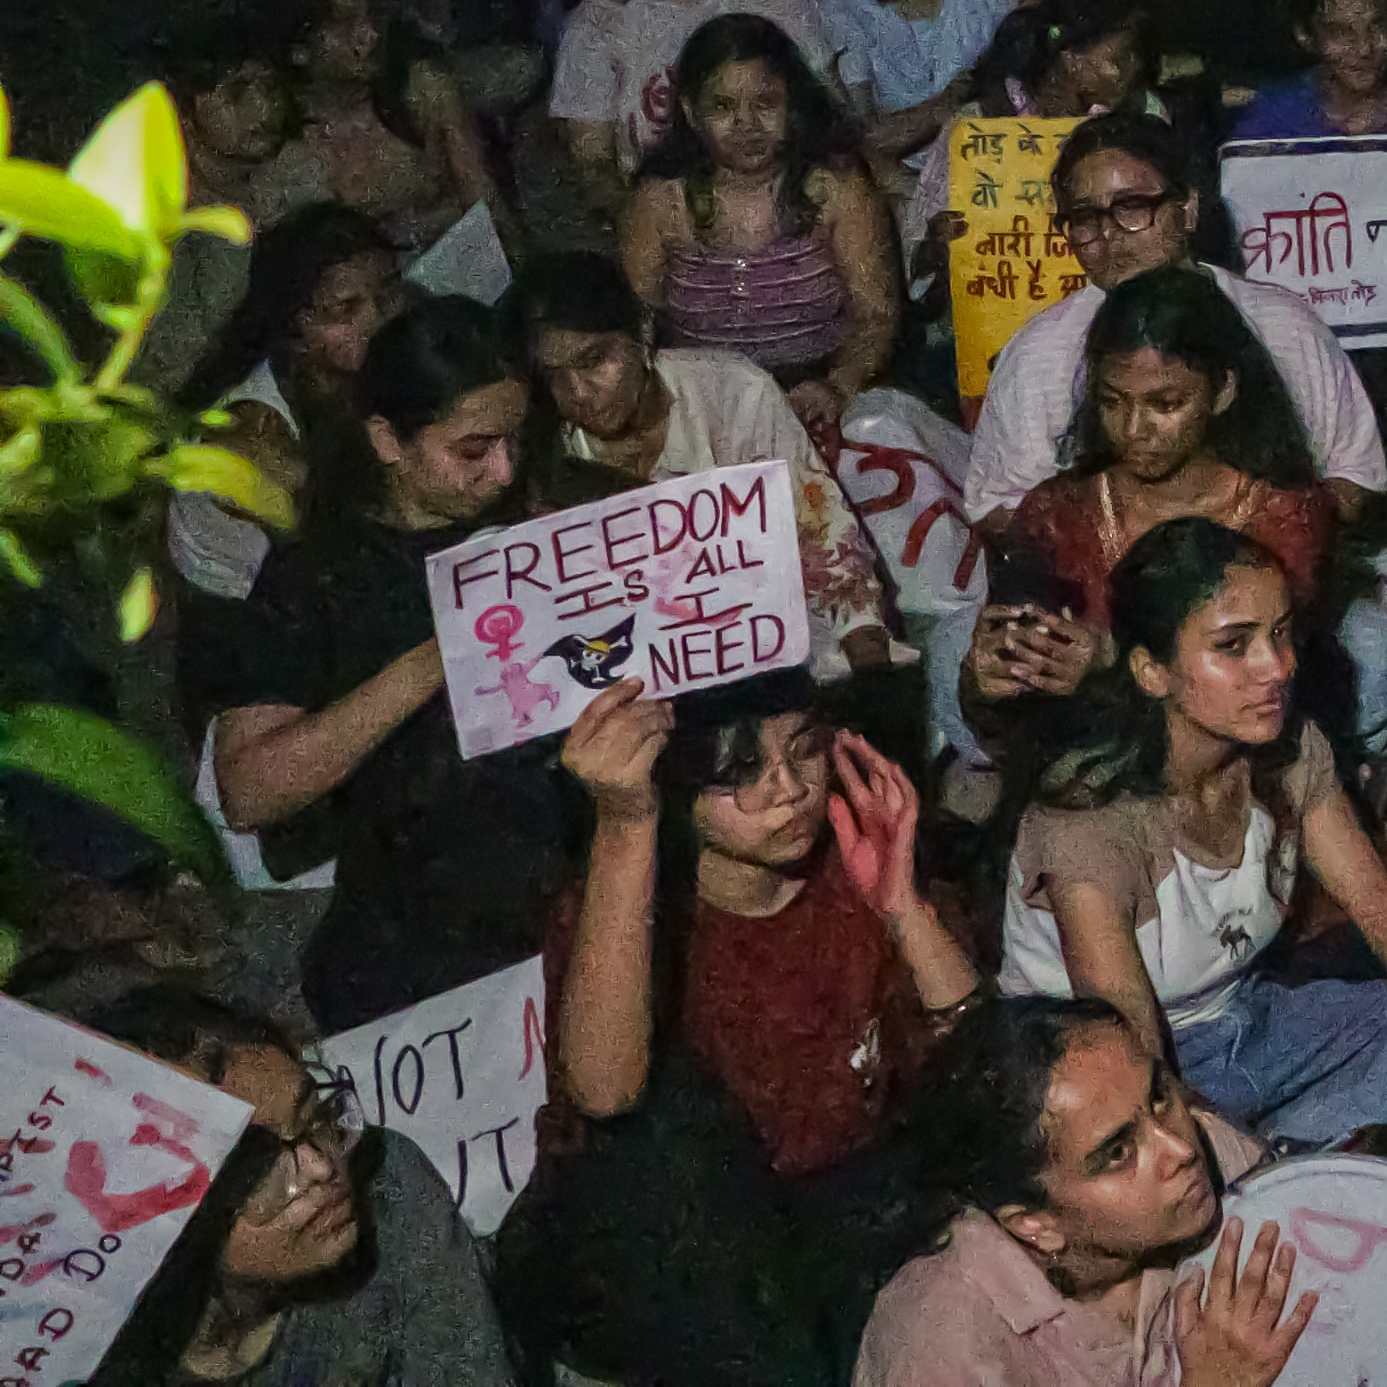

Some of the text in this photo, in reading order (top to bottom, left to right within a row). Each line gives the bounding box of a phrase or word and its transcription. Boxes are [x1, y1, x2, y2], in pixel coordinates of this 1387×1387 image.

[453, 475, 767, 610] FREEDOM
[553, 539, 765, 621] IS ALL
[657, 587, 754, 631] I
[648, 614, 785, 691] NEED
